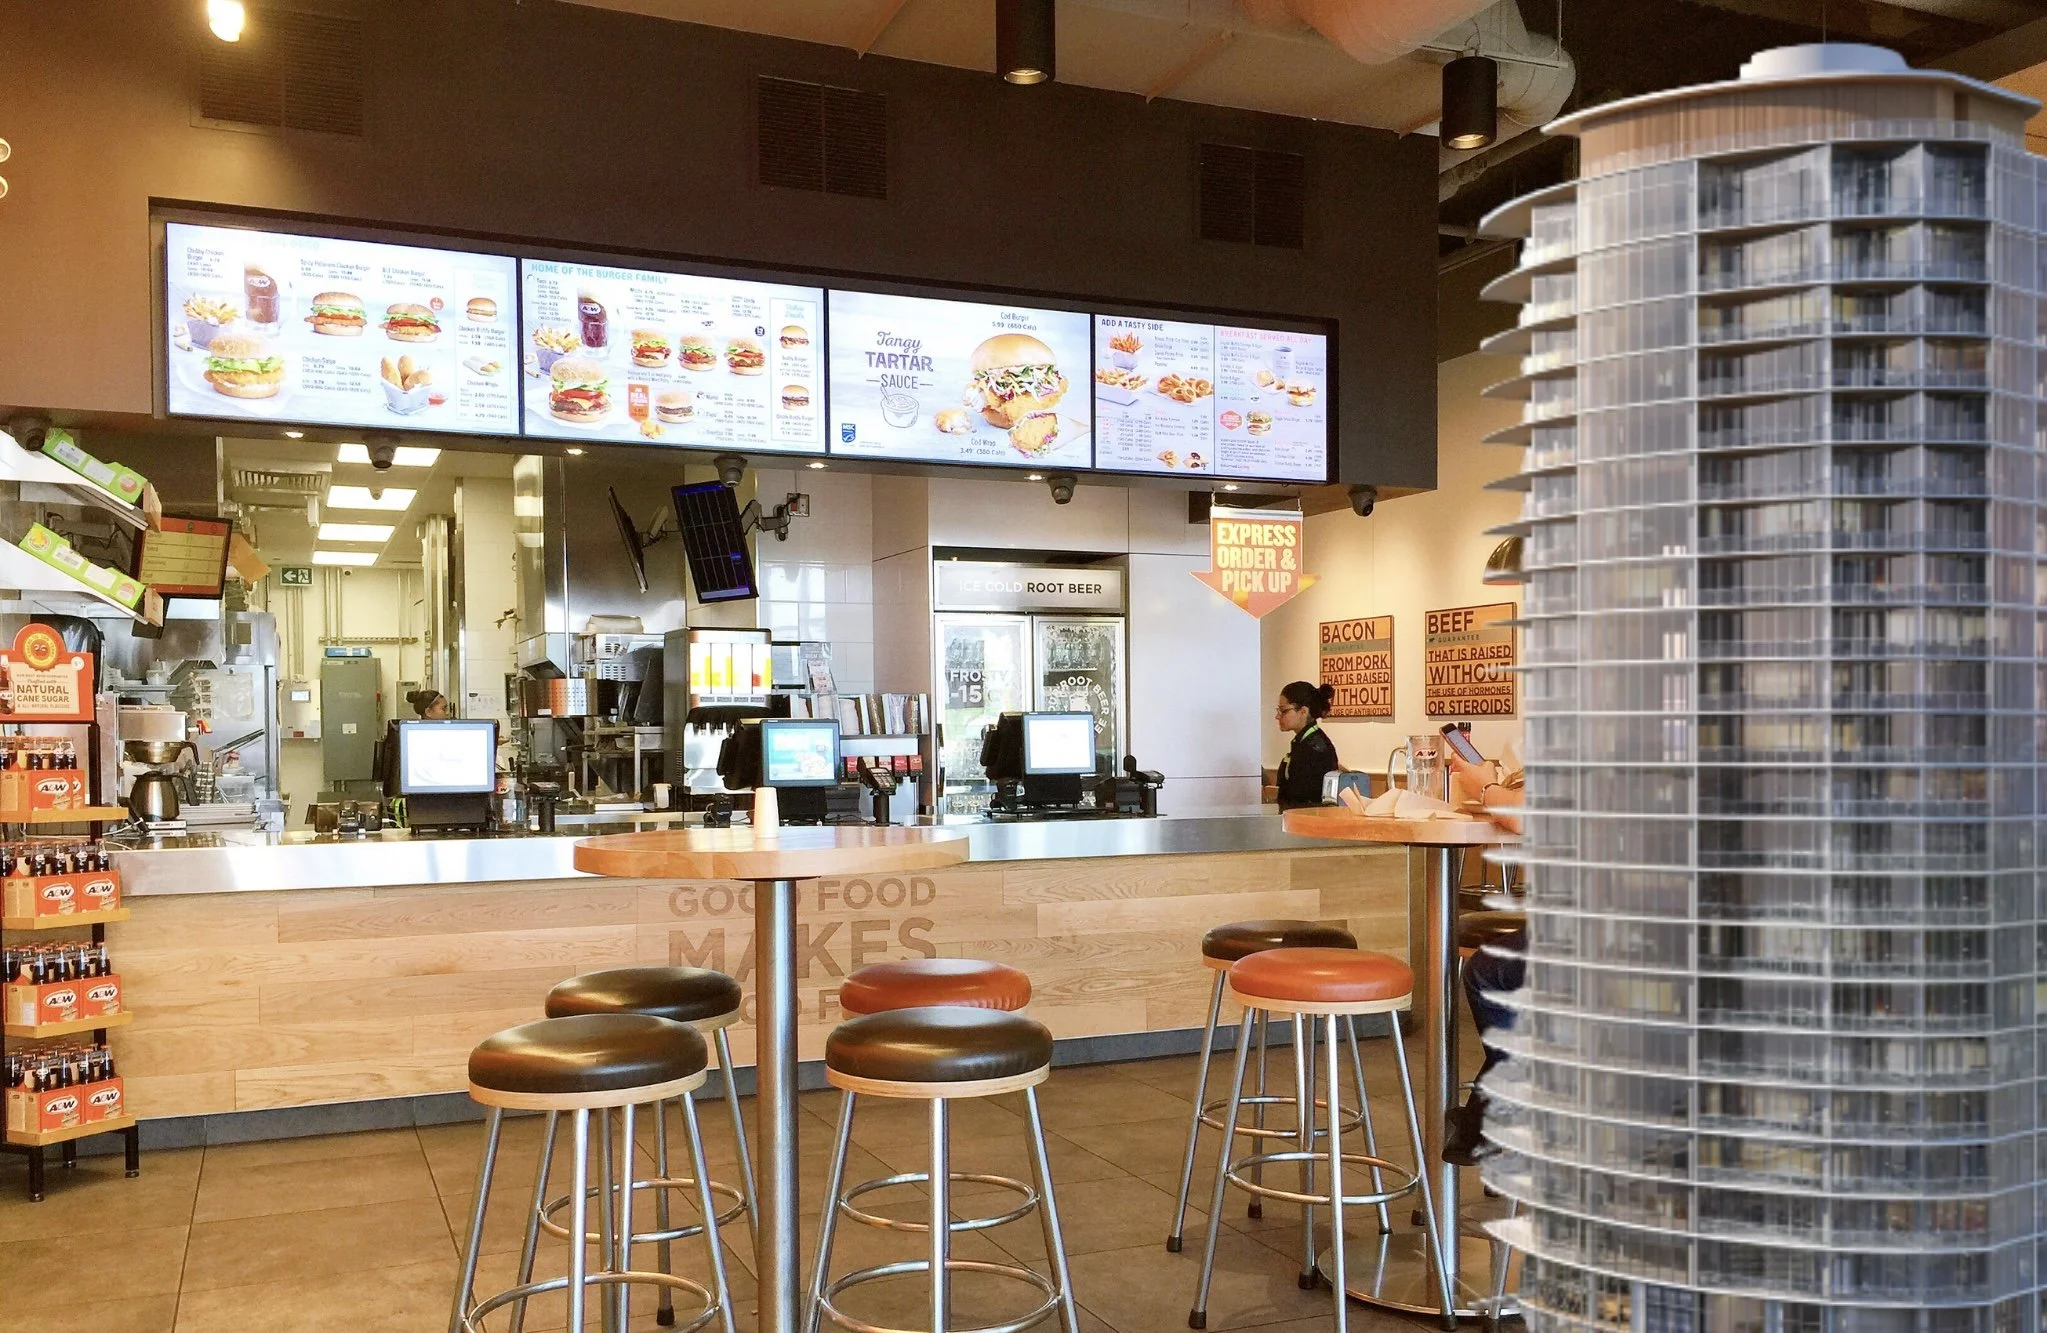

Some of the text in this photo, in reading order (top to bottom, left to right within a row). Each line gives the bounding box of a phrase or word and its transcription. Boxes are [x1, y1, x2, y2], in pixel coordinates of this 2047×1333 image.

[531, 263, 668, 285] HOME OF THE BURGER FAMILY
[1001, 312, 1011, 320] Cod
[1101, 319, 1116, 327] ADD
[1124, 321, 1145, 331] TASTY
[1148, 324, 1164, 332] SIDE
[877, 331, 923, 355] Tangy
[865, 351, 935, 373] TARTAR
[881, 373, 919, 389] SAUCE
[1217, 523, 1297, 547] EXPRESS
[1217, 547, 1297, 571] ORDER &
[960, 581, 1102, 594] ICE COLD ROOT BEER
[1222, 570, 1293, 593] PICK UP
[1428, 610, 1474, 634] BEEF
[1322, 621, 1375, 644] BACON
[1428, 645, 1511, 662] THAT IS RAISED
[1322, 653, 1388, 672] FROM PORK
[1322, 671, 1390, 685] THAT IS RAISED
[1429, 661, 1511, 684] WITHOUT
[17, 684, 69, 695] NATURAL
[1060, 676, 1093, 689] ROOT
[17, 695, 70, 703] CANE SUGAR
[951, 684, 983, 703] -15
[1428, 686, 1511, 697] THE USE OF HORMONES
[1093, 684, 1110, 715] BEER
[1428, 698, 1511, 714] OR STEROIDS
[1354, 707, 1389, 716] ANTIBIOTICS
[40, 784, 67, 793] A&W
[46, 889, 72, 898] A&W
[88, 885, 113, 895] A&W
[669, 877, 936, 918] GOO FOOD
[48, 995, 74, 1006] A&W
[91, 989, 115, 1000] A&W
[93, 1092, 117, 1104] A&W
[49, 1101, 75, 1112] A&W
